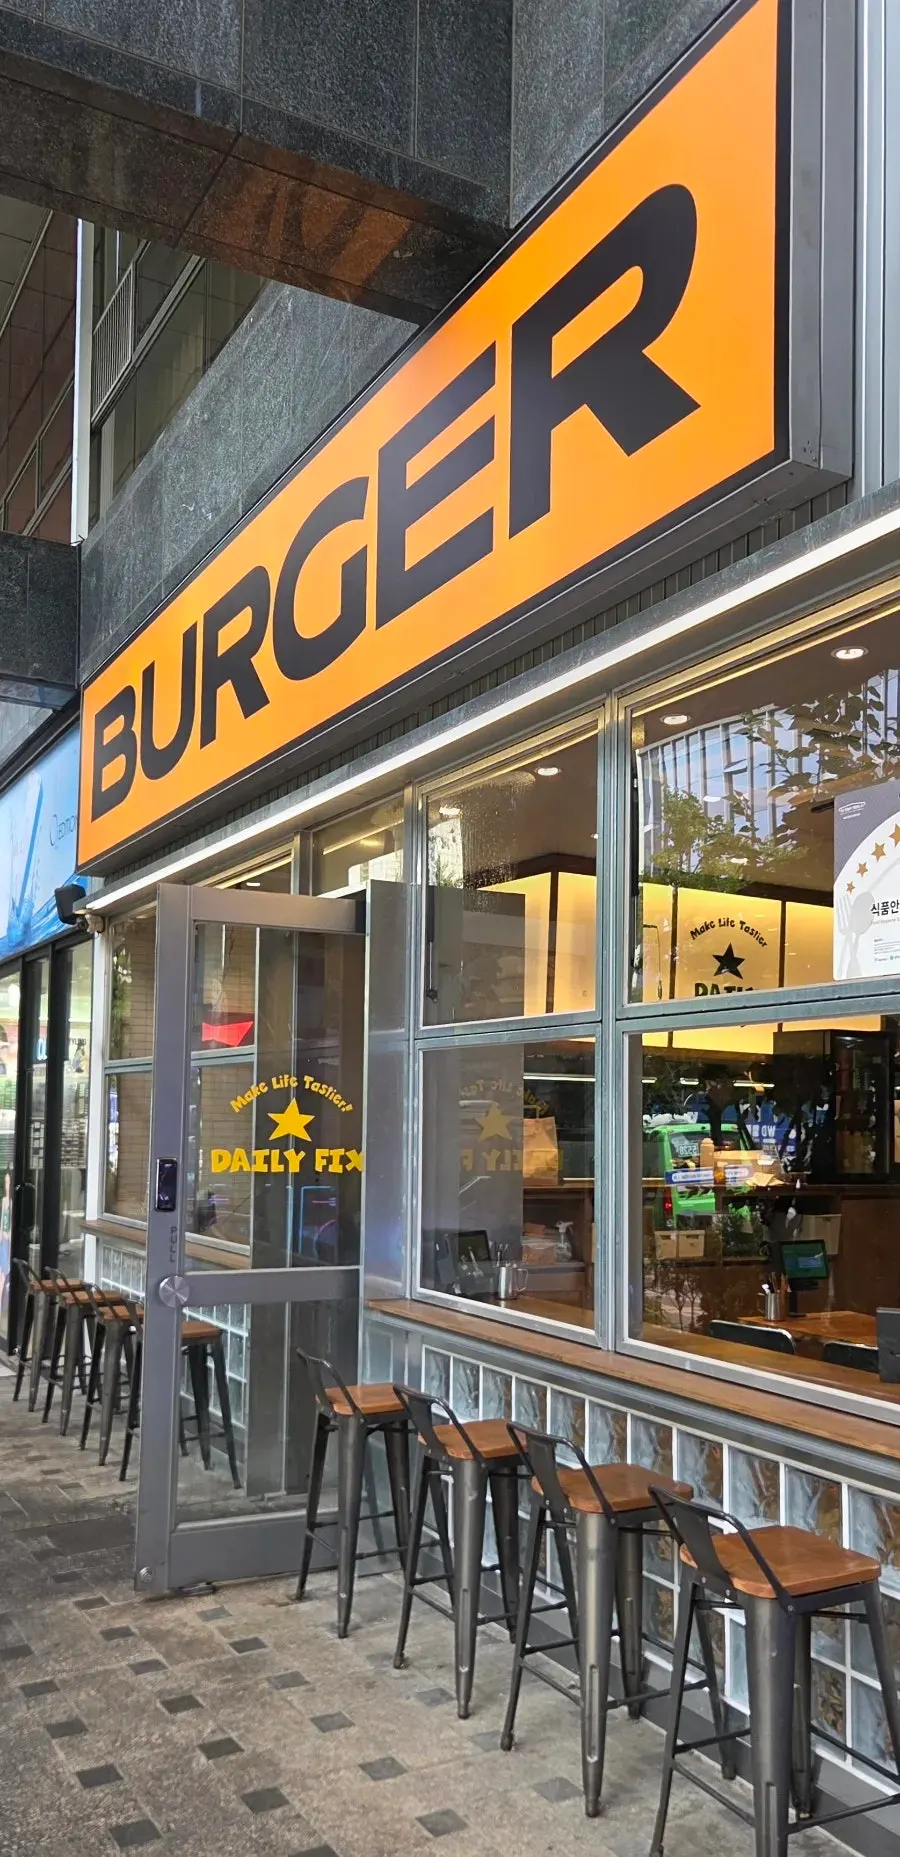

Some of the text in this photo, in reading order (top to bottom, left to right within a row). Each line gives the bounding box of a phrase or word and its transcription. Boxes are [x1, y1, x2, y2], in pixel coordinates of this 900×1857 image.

[91, 183, 700, 822] BURGER
[689, 917, 768, 948] Make Life Tastier
[230, 1074, 354, 1113] Make Life Tastier!
[211, 1148, 365, 1174] DAILY FIX
[170, 1225, 178, 1263] PULL
